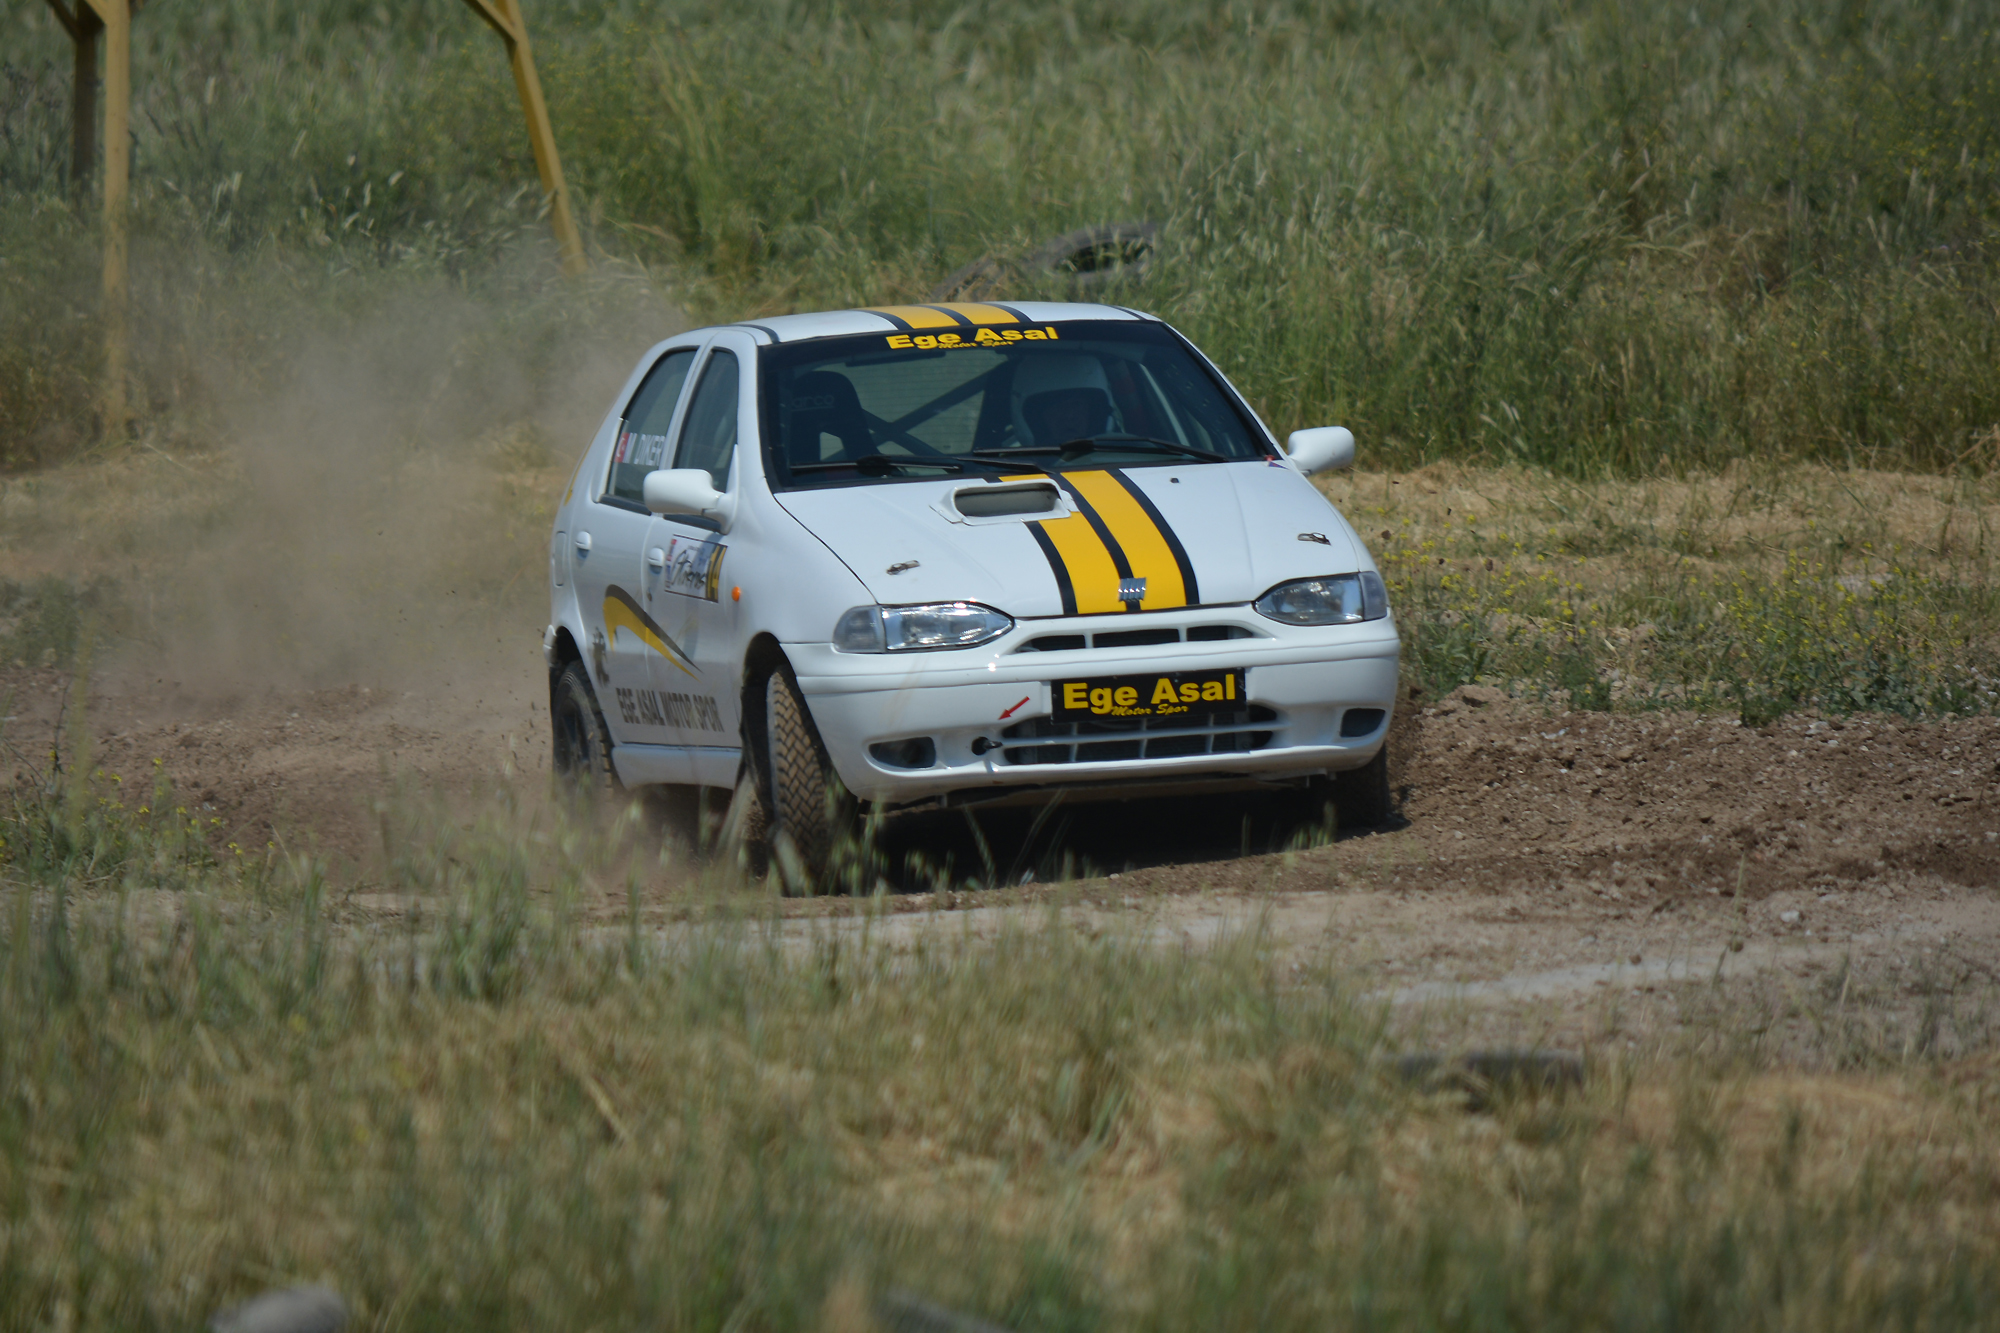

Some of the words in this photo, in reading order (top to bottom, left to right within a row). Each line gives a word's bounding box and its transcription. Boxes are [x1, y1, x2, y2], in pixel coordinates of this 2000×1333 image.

[886, 333, 962, 350] Ege
[974, 326, 1060, 342] Asal
[615, 687, 641, 724] EGE
[635, 689, 666, 726] ASAL
[658, 690, 699, 730] MOTOR
[692, 693, 725, 732] SPOR
[1063, 683, 1138, 714] Ege
[1150, 673, 1236, 704] Asal
[1111, 705, 1152, 717] Motor
[1156, 703, 1189, 716] Spor
